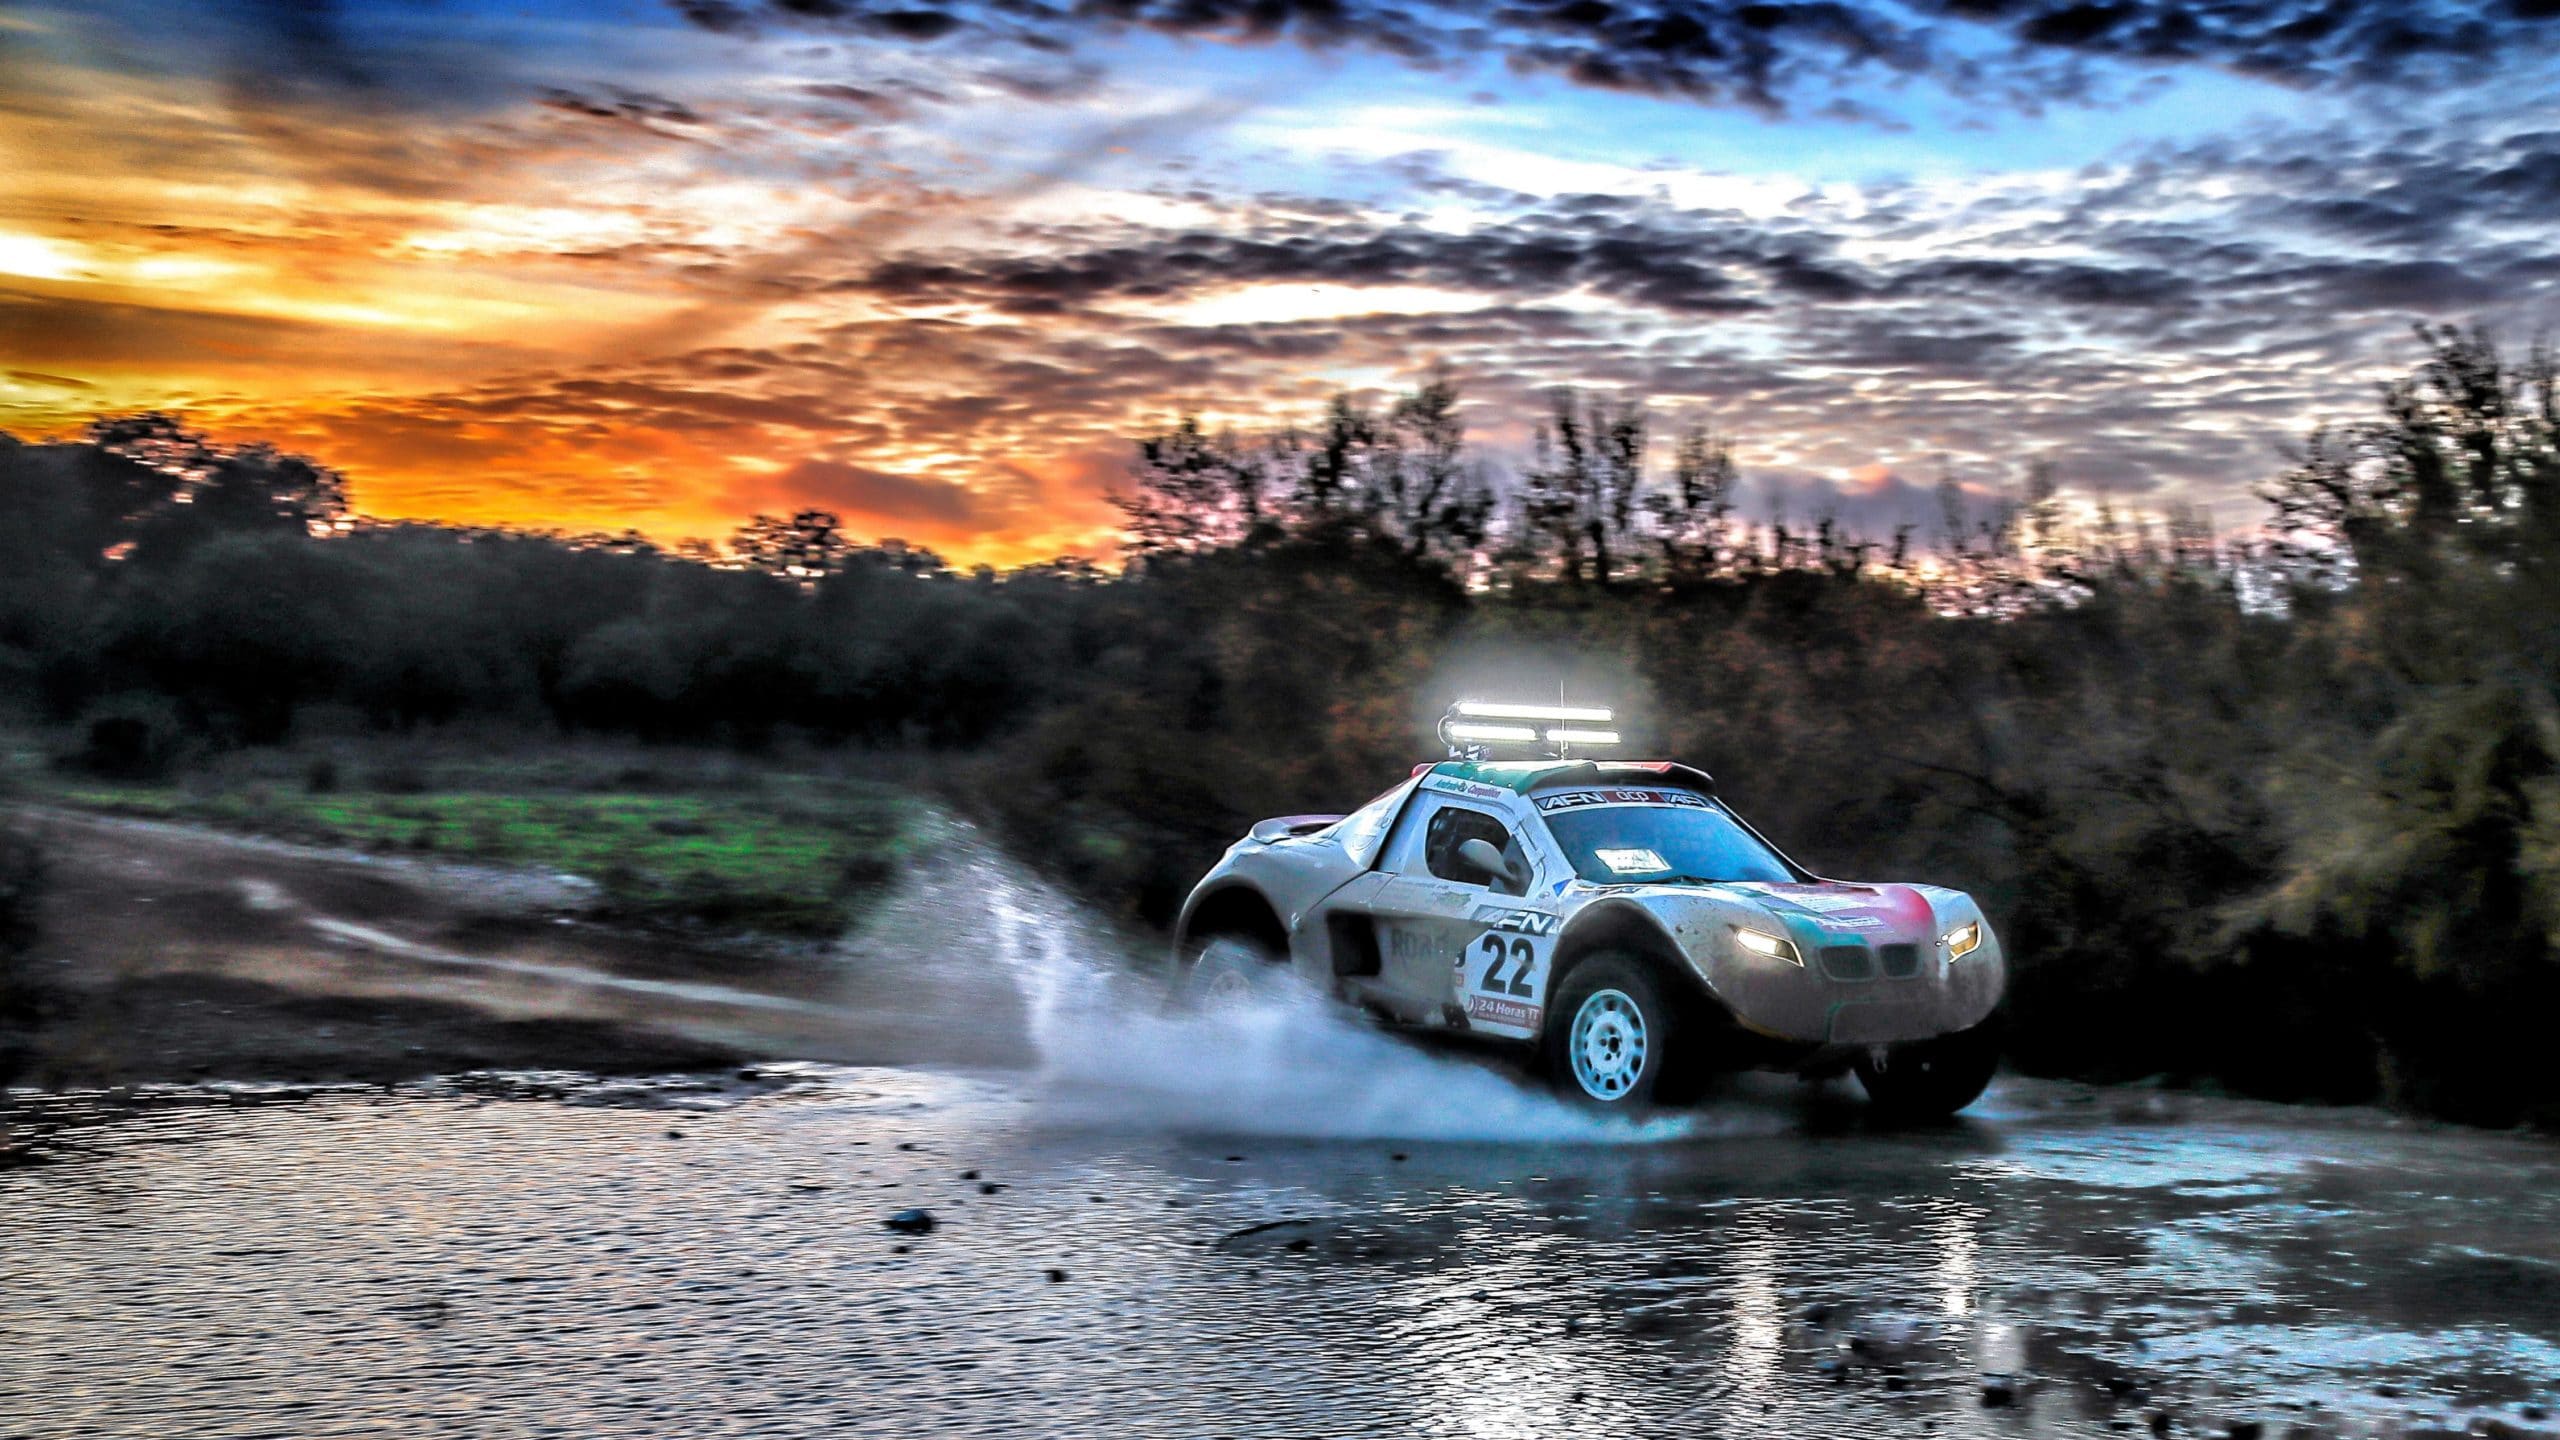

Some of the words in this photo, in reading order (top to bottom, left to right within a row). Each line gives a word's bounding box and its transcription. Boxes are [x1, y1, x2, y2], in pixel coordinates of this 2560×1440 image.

[1546, 792, 1605, 809] AFN
[1481, 934, 1534, 999] 22
[1478, 1000, 1494, 1013] 24
[1496, 1001, 1526, 1018] Horas
